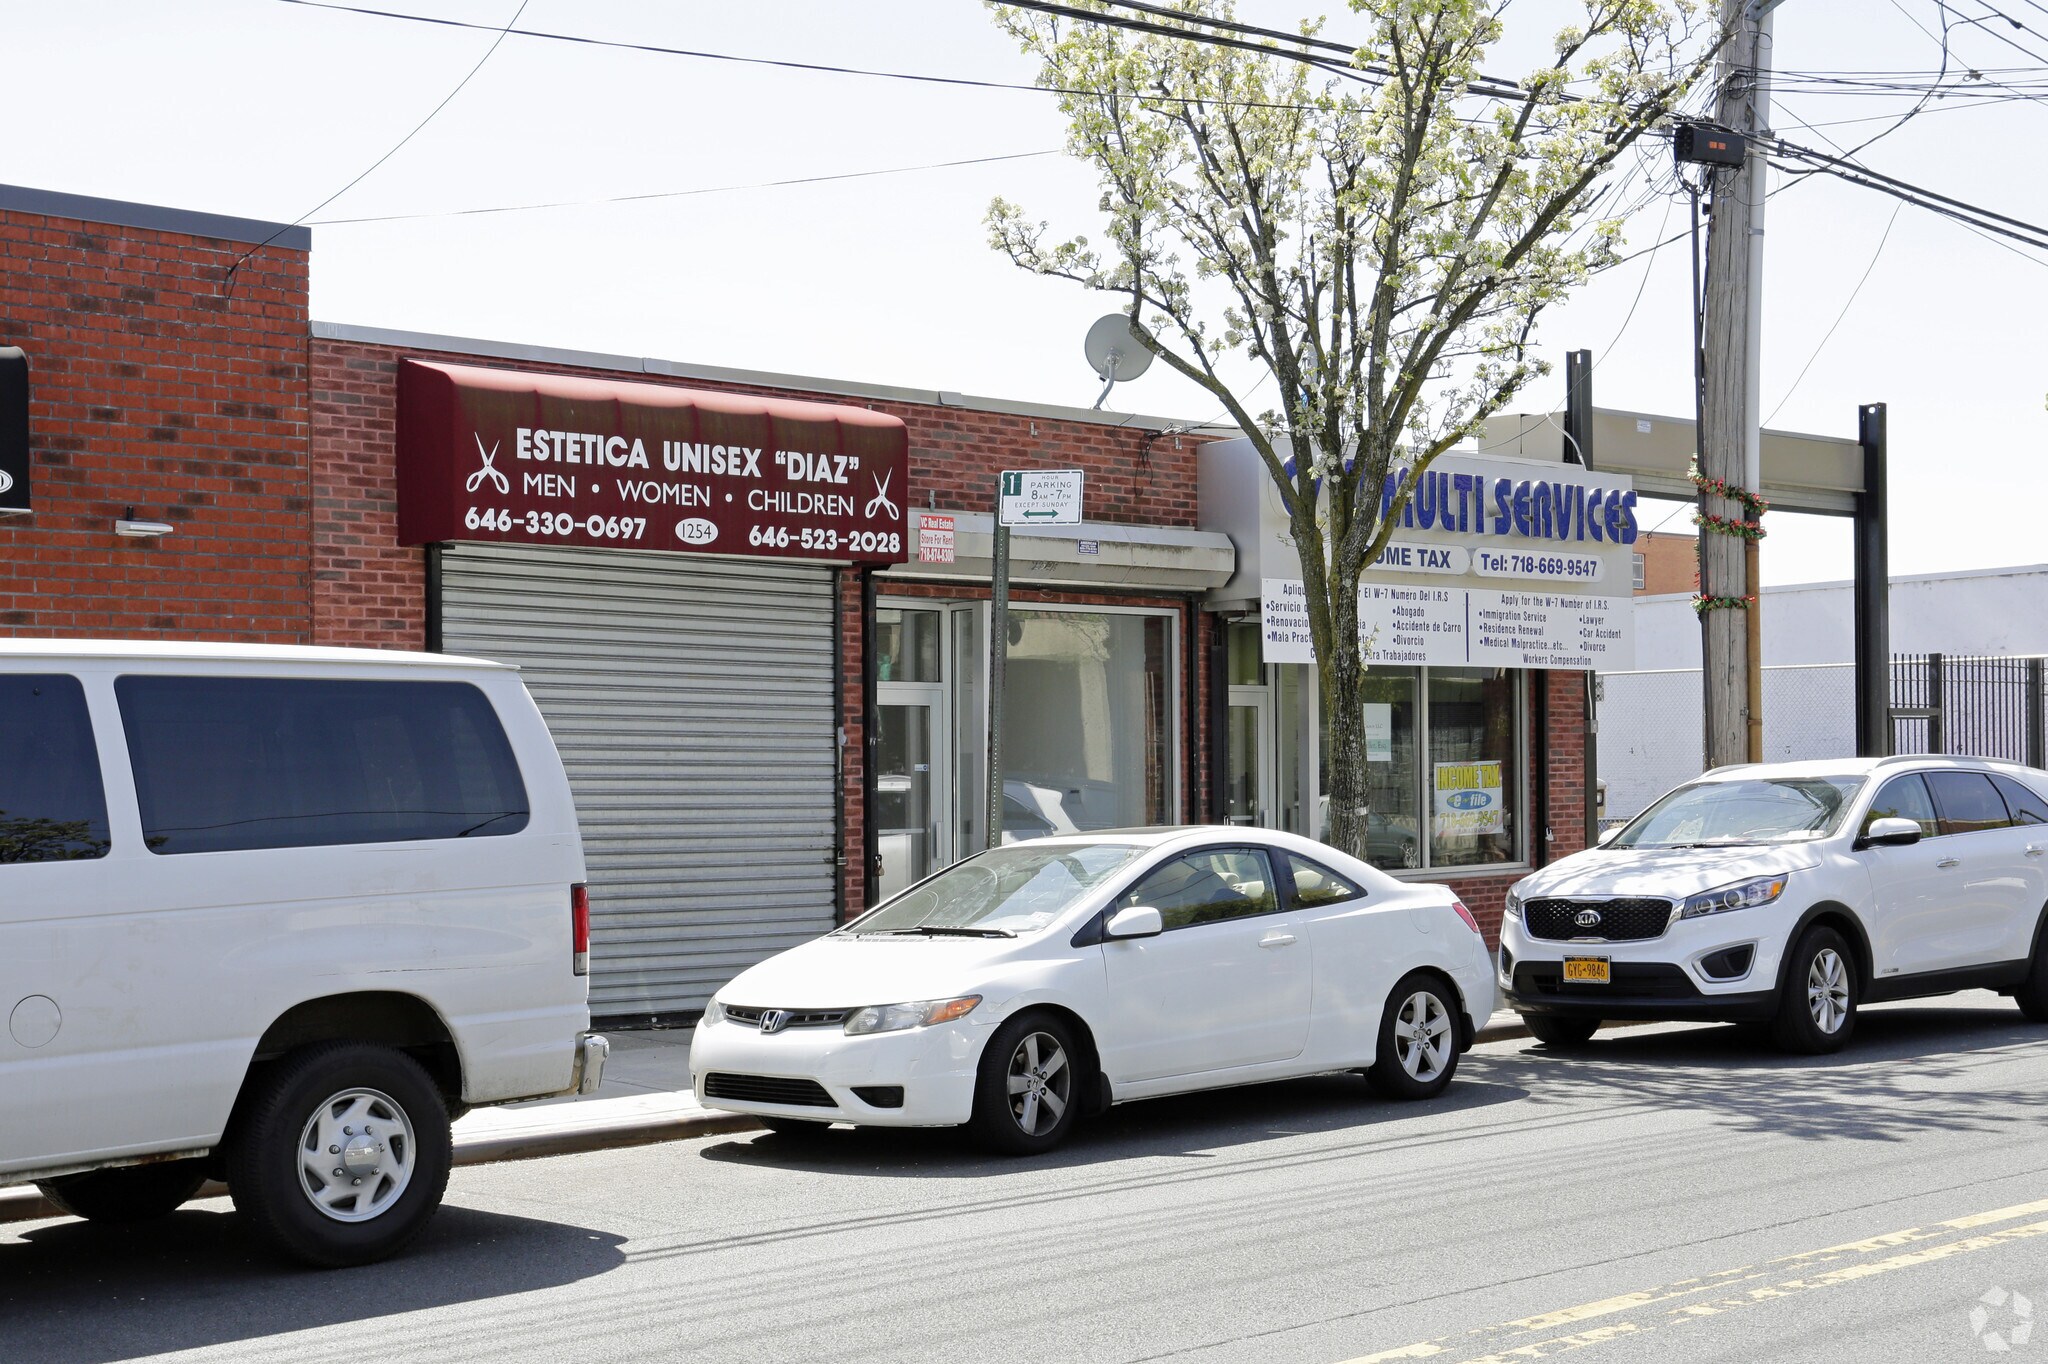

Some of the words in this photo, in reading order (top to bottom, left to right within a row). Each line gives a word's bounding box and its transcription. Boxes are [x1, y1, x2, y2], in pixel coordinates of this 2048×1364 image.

[516, 427, 649, 469] ESTETICA
[663, 441, 762, 478] UNISEX
[1009, 475, 1015, 495] 1
[1030, 481, 1072, 489] PARKING
[523, 472, 575, 498] MEN
[616, 478, 711, 507] WOMEN
[747, 489, 854, 517] CHILDREN
[1494, 478, 1638, 545] SERVICES
[464, 506, 647, 540] 646-330-0697
[681, 522, 712, 541] 1254
[748, 524, 901, 554] 646-523-2028
[1417, 548, 1451, 569] TAX
[1480, 553, 1508, 572] Tel:
[1511, 555, 1597, 577] 718-669-9547
[1364, 587, 1371, 598] El
[1374, 587, 1389, 599] W-7
[1419, 590, 1431, 602] Del
[1270, 600, 1301, 612] Servicio
[1501, 594, 1519, 607] Apply
[1521, 595, 1531, 606] for
[1533, 596, 1543, 607] the
[1545, 597, 1558, 608] W-7
[1560, 598, 1584, 609] Number
[1585, 600, 1592, 610] of
[1396, 606, 1425, 619] Abogado
[1482, 609, 1521, 622] Immigration
[1523, 611, 1547, 623] Service
[1270, 616, 1309, 628] Renovacio
[1396, 620, 1430, 632] Accidente
[1432, 621, 1441, 632] de
[1442, 622, 1462, 633] Carro
[1582, 615, 1605, 626] Lawyer
[1483, 623, 1516, 635] Residence
[1518, 625, 1544, 636] Renewal
[1582, 628, 1593, 639] Car
[1595, 628, 1622, 639] Accident
[1271, 631, 1289, 643] Mala
[1396, 634, 1424, 646] Divorcio
[1484, 636, 1509, 648] Medical
[1583, 641, 1606, 652] Divorce
[1382, 649, 1427, 662] Trabajadores
[1522, 653, 1548, 665] Workers
[1550, 654, 1592, 667] Compensation
[1437, 765, 1479, 790] INCOME
[1480, 764, 1501, 788] TAX
[1578, 914, 1596, 924] KIA
